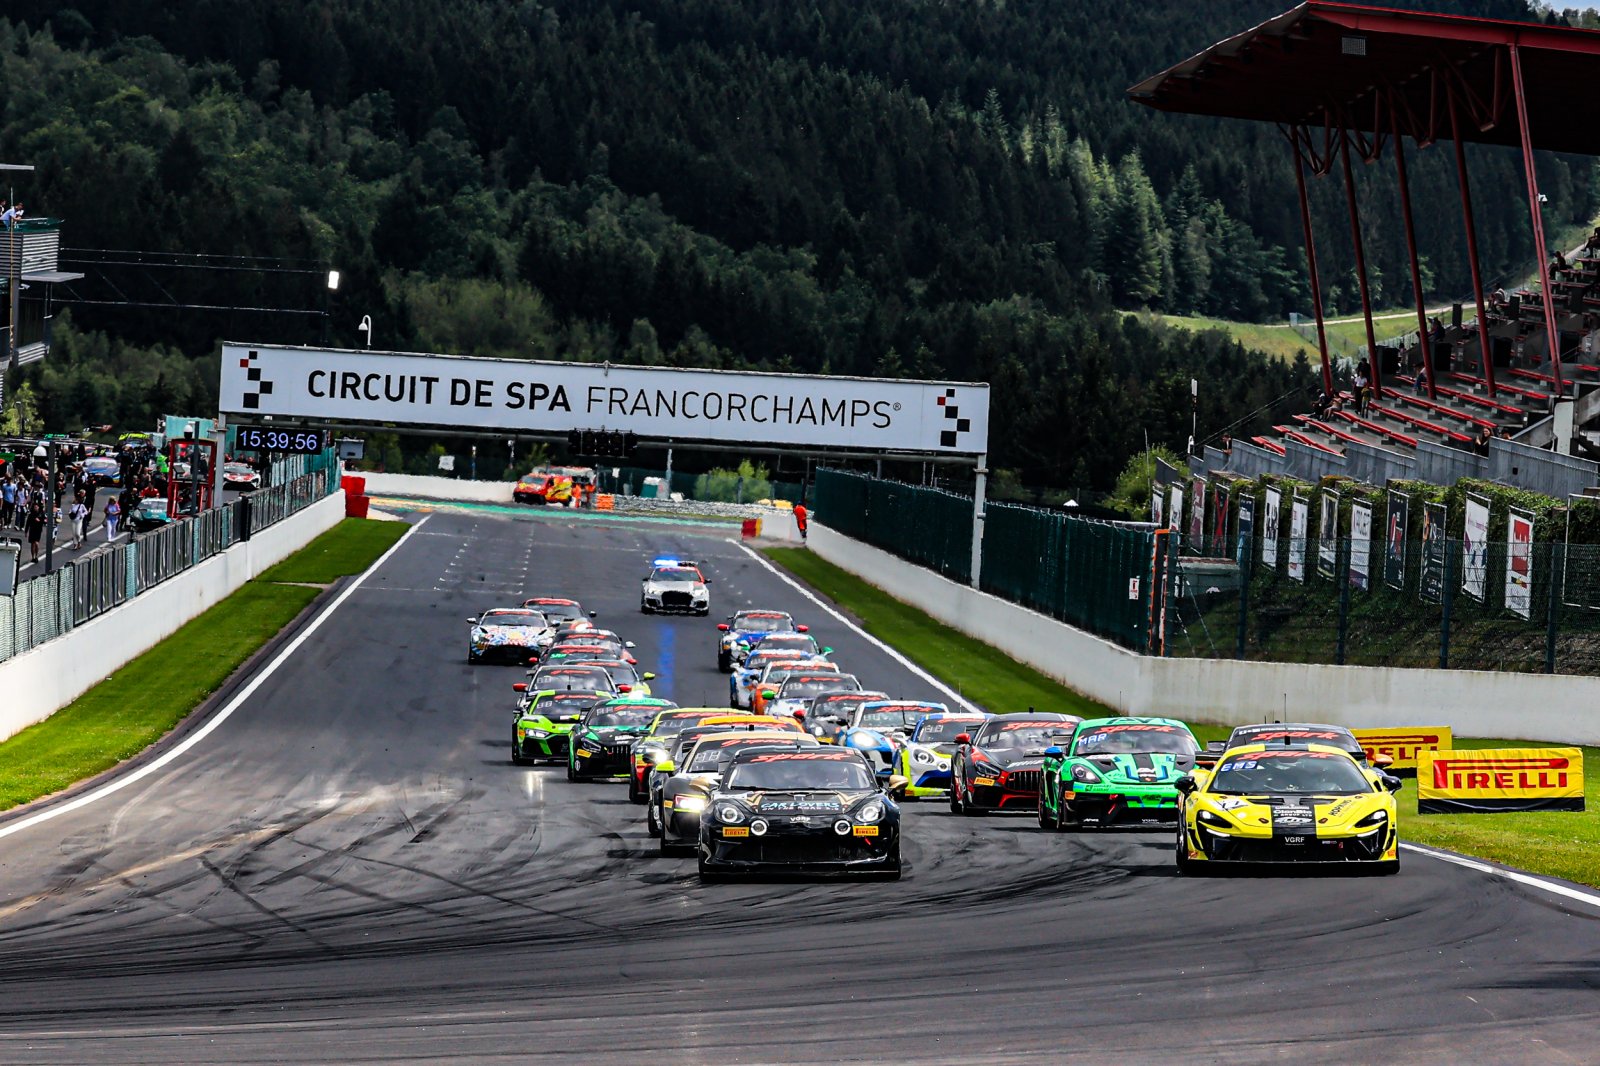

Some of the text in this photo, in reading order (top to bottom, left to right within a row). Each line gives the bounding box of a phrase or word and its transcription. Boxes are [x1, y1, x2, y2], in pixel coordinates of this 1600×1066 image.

[307, 369, 440, 405] CIRCUIT
[449, 378, 494, 407] DE
[504, 381, 572, 413] SPA
[239, 430, 318, 451] 15:39:56
[1078, 733, 1107, 747] MAR
[1220, 760, 1257, 773] EMS
[1433, 758, 1570, 789] PIRELLI
